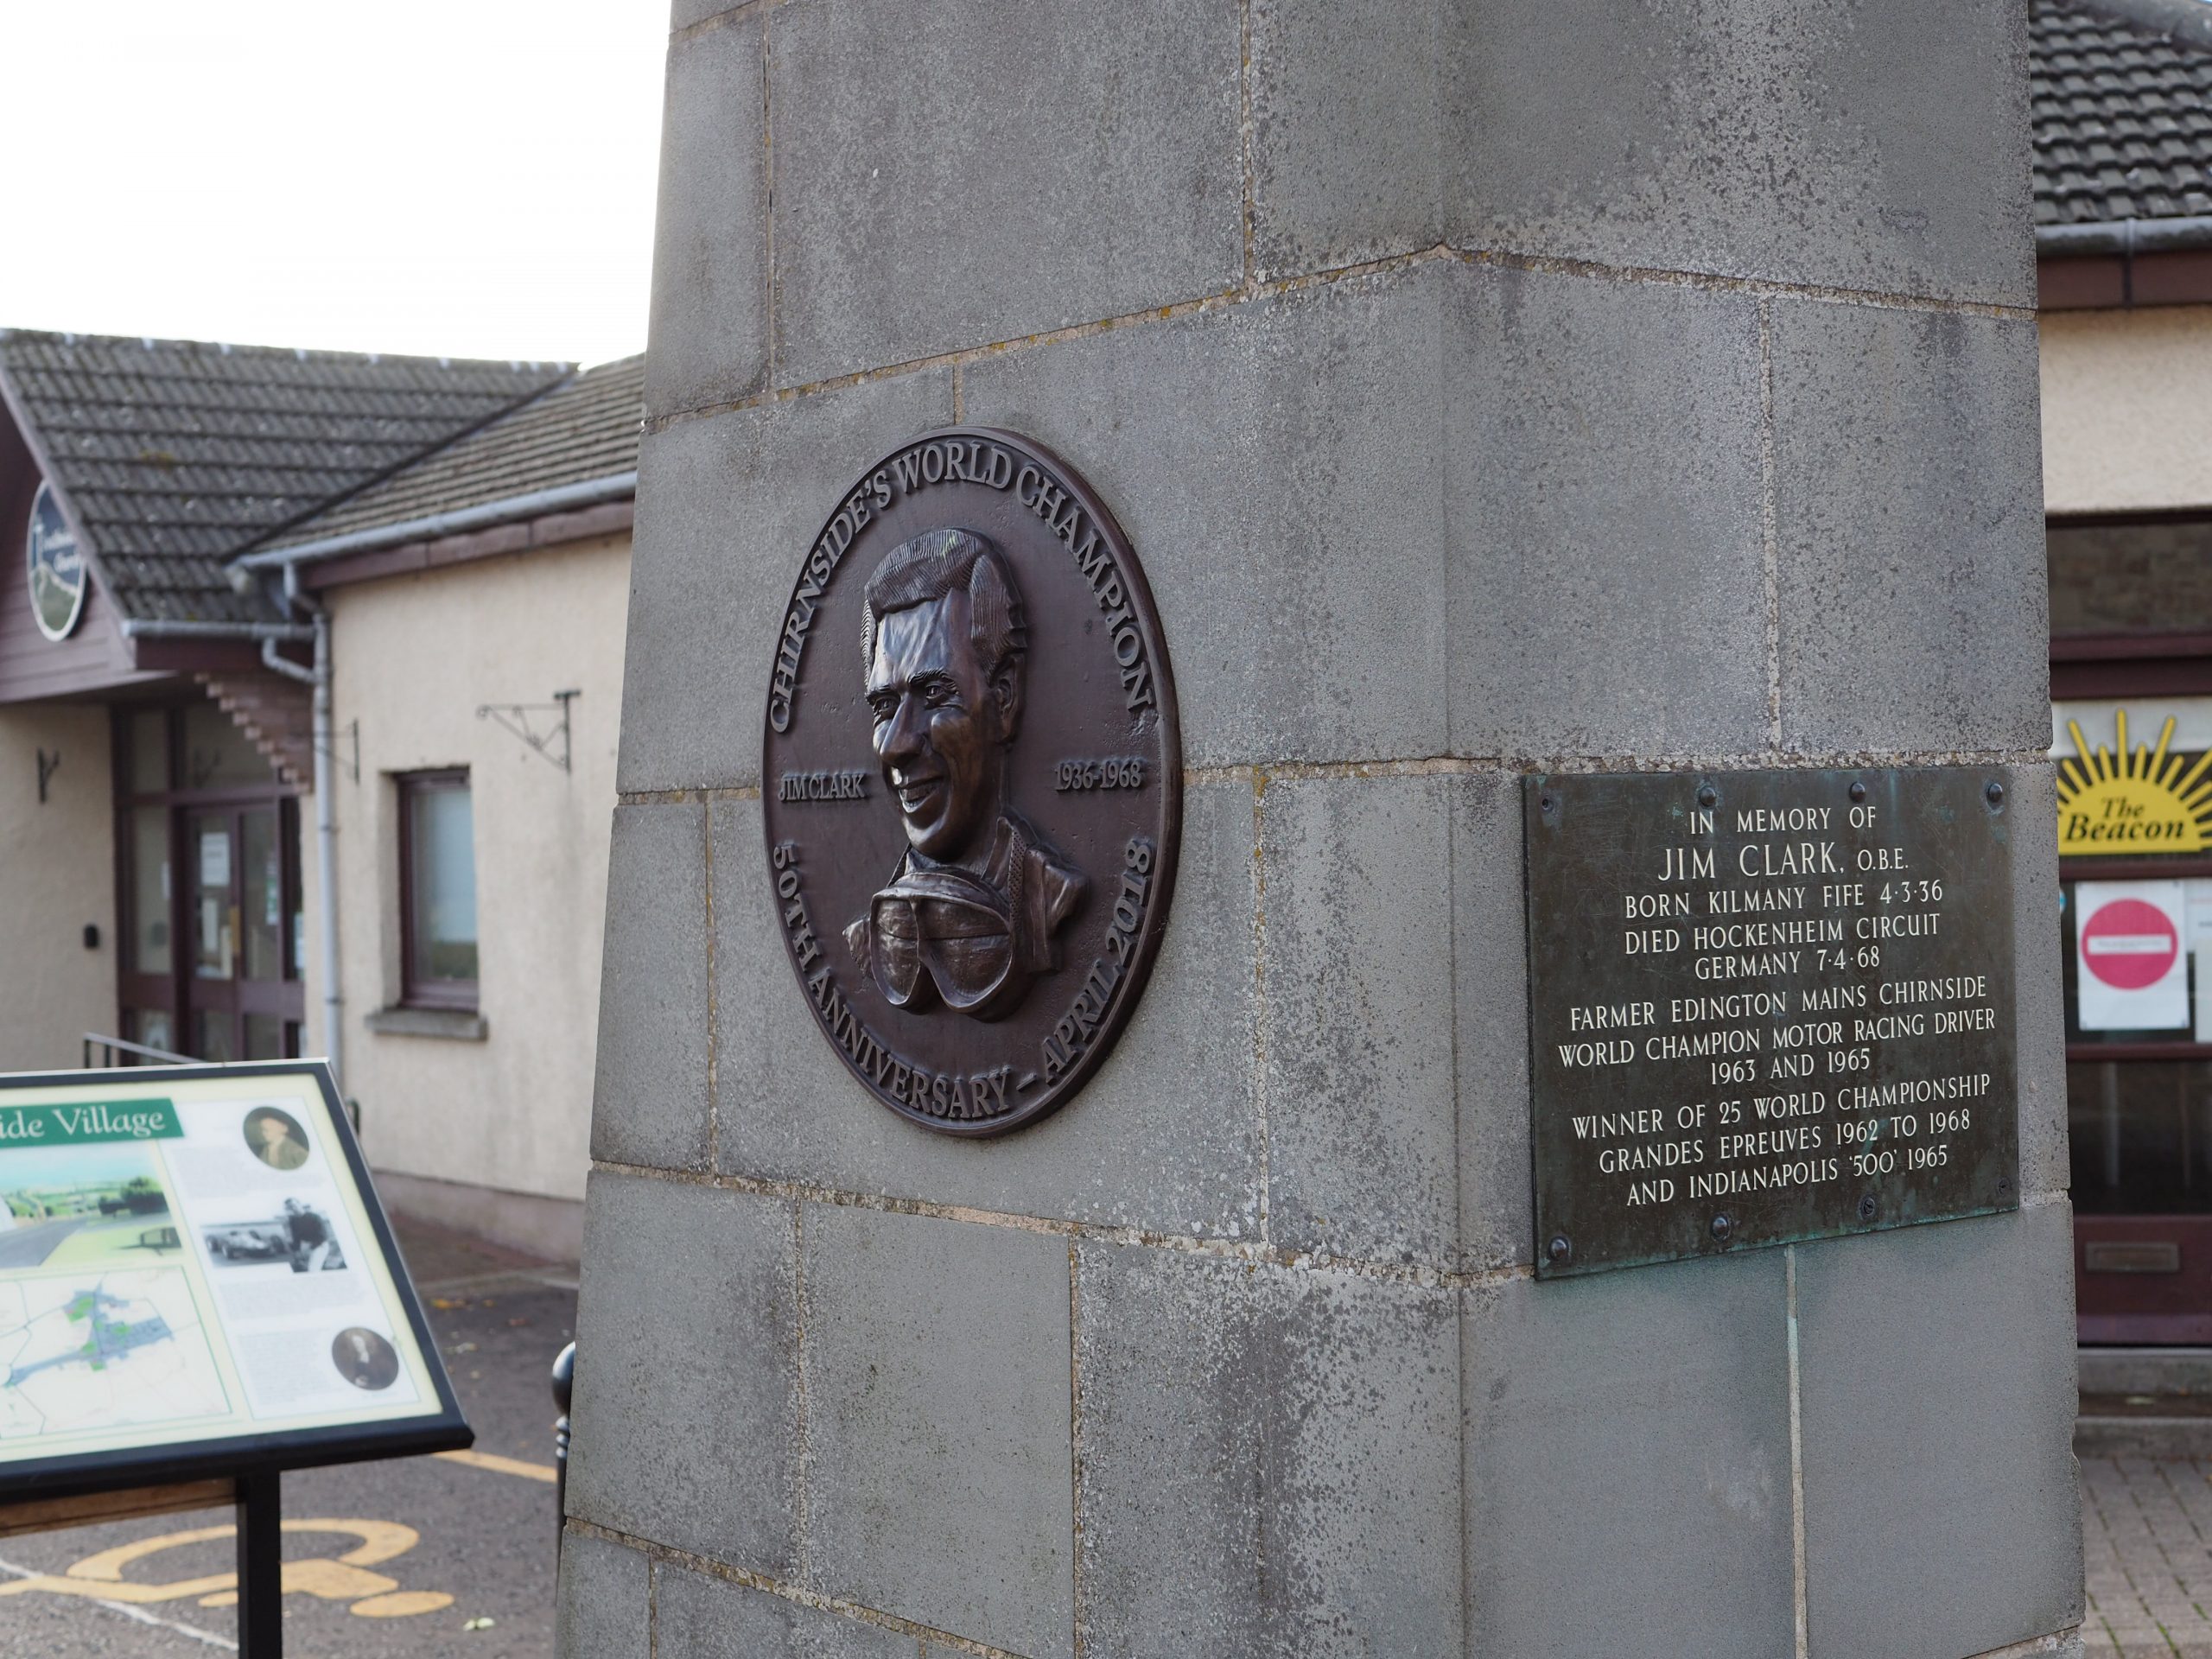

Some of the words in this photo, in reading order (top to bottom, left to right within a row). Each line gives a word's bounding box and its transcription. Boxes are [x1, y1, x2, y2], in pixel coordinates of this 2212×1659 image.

[892, 441, 1013, 493] WORLD
[1015, 465, 1154, 713] CHAMPION
[779, 774, 809, 802] JIM
[809, 772, 866, 800] CLARK
[1054, 760, 1143, 793] 1936-1968
[1689, 810, 1714, 835] IN
[1737, 807, 1832, 833] MEMORY
[1849, 805, 1876, 829] OF
[2101, 796, 2145, 818] The
[2063, 813, 2183, 842] Beacon
[1657, 847, 1716, 881] JIM
[1856, 848, 1909, 871] O.B.E.
[1624, 892, 1690, 918] BORN
[1708, 887, 1806, 914] KILMANY
[1822, 883, 1865, 908] FIFE
[1624, 929, 1681, 955] DIED
[1694, 918, 1844, 950] HOCKENHEIM
[1856, 912, 1941, 939] CIRCUIT
[772, 842, 821, 971] 50TH
[809, 968, 1013, 1119] ANNIVERSARY
[1041, 959, 1123, 1085] APRIL
[1106, 838, 1154, 959] 2018
[1694, 950, 1802, 980] GERMANY
[1570, 1001, 1656, 1032] FARMER
[1670, 991, 1787, 1023] EDINGTON
[1802, 984, 1866, 1012] MAINS
[1878, 976, 1986, 1005] CHIRNSIDE
[1557, 1039, 1635, 1068] WORLD
[1645, 1027, 1760, 1060] CHAMPION
[1772, 1021, 1844, 1050] MOTOR
[1853, 1014, 1925, 1042] RACING
[1934, 1007, 1995, 1034] DRIVER
[1711, 1058, 1756, 1085] 1963
[1770, 1053, 1815, 1079] AND
[1827, 1047, 1871, 1073] 1965
[52, 1105, 166, 1139] Village
[1571, 1109, 1664, 1140] WINNER
[1677, 1103, 1706, 1129] OF
[1719, 1100, 1741, 1125] 25
[1752, 1091, 1826, 1121] WORLD
[1837, 1073, 1991, 1110] CHAMPIONSHIP
[1599, 1139, 1704, 1173] GRANDES
[1719, 1125, 1821, 1160] EPREUVES
[1837, 1121, 1879, 1146] 1962
[1890, 1115, 1917, 1139] TO
[1929, 1109, 1971, 1135] 1968
[1626, 1179, 1675, 1206] AND
[1689, 1157, 1838, 1198] INDIANAPOLIS
[1907, 1144, 1948, 1171] 1965
